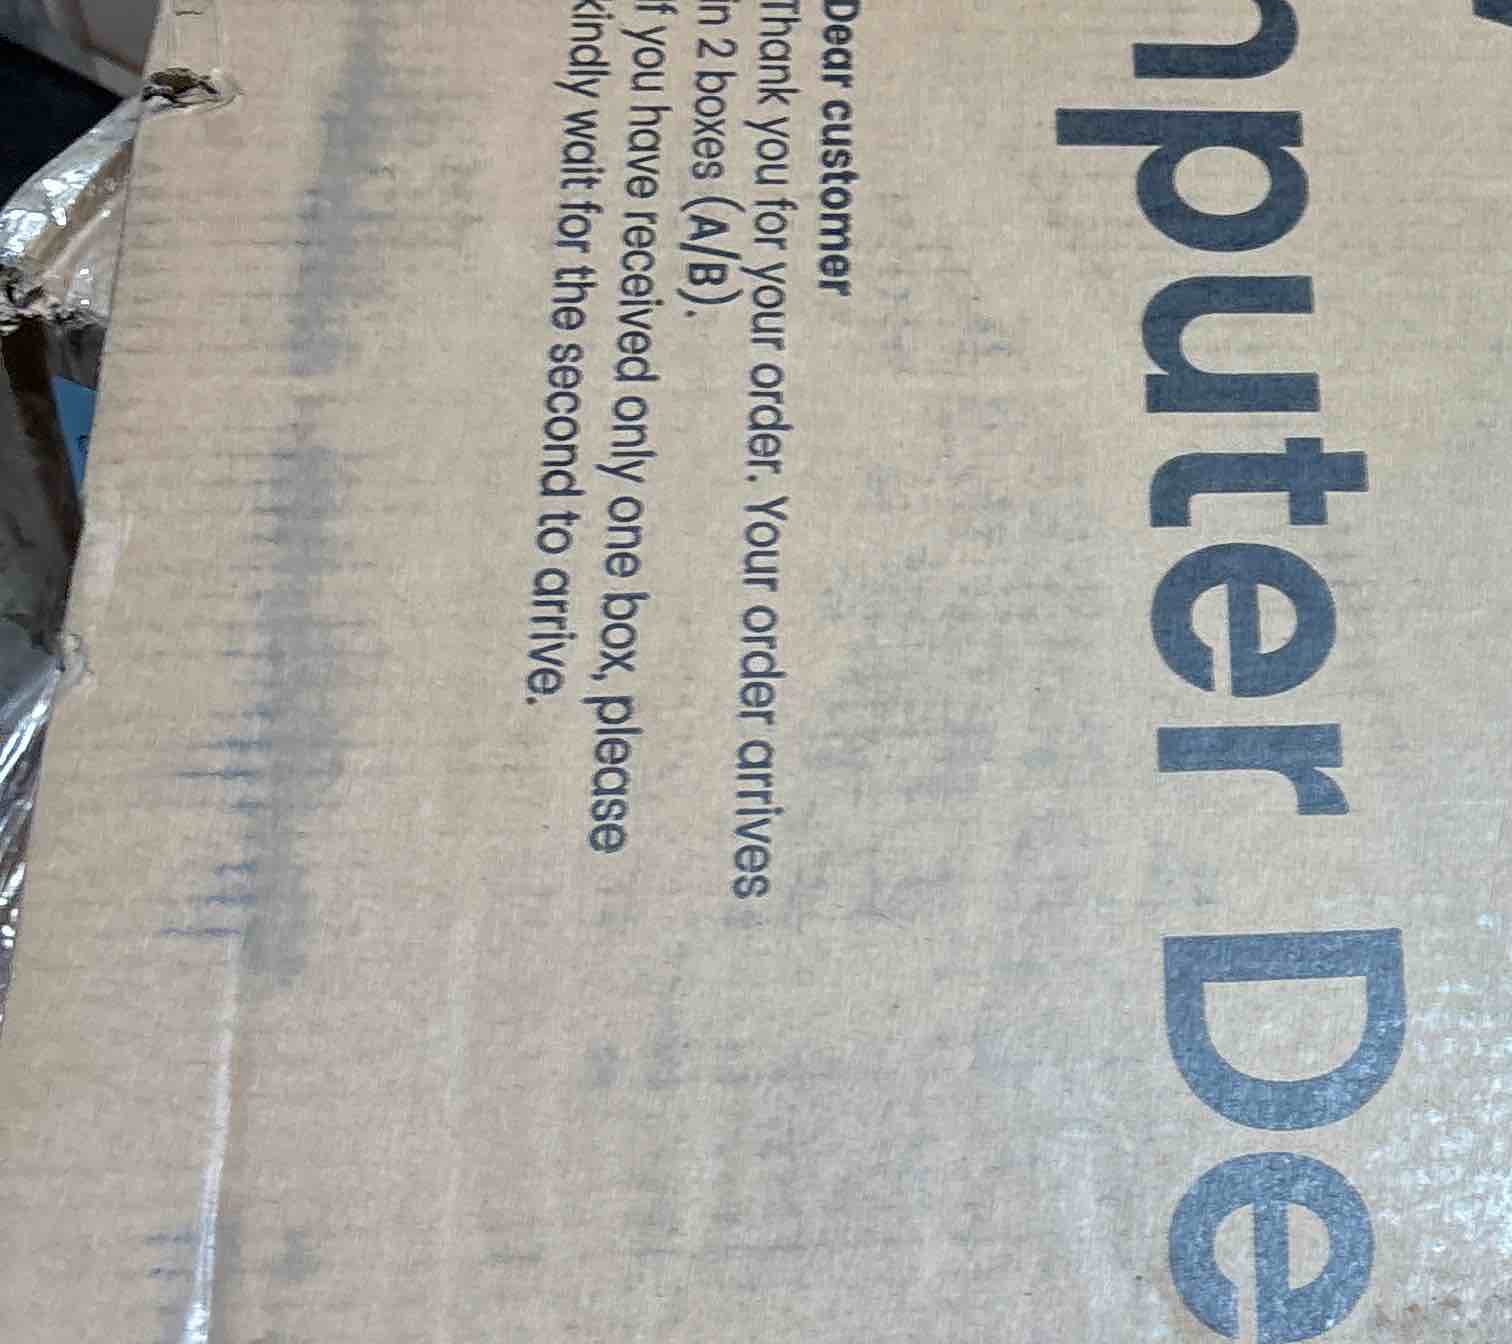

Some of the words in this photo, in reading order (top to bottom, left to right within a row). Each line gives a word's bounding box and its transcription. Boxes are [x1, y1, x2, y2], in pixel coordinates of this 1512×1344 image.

[621, 25, 668, 92] you
[697, 37, 739, 60] 2
[559, 108, 607, 191] wait
[625, 106, 674, 200] have
[689, 70, 739, 181] boxes
[743, 116, 791, 185] you
[553, 202, 604, 255] for
[751, 198, 799, 251] for
[817, 99, 861, 297] customer
[550, 264, 599, 331] the
[613, 211, 665, 382] received
[676, 196, 747, 318] (A/B).
[739, 262, 788, 351] your
[539, 342, 587, 497] second
[593, 395, 659, 484] only
[745, 362, 795, 482] order.
[535, 510, 582, 555] to
[603, 496, 645, 579] one
[742, 496, 789, 593] Your
[524, 567, 578, 706] arrive.
[590, 591, 651, 681] box,
[736, 605, 788, 726] order
[579, 696, 645, 855] please
[731, 739, 785, 899] arrives
